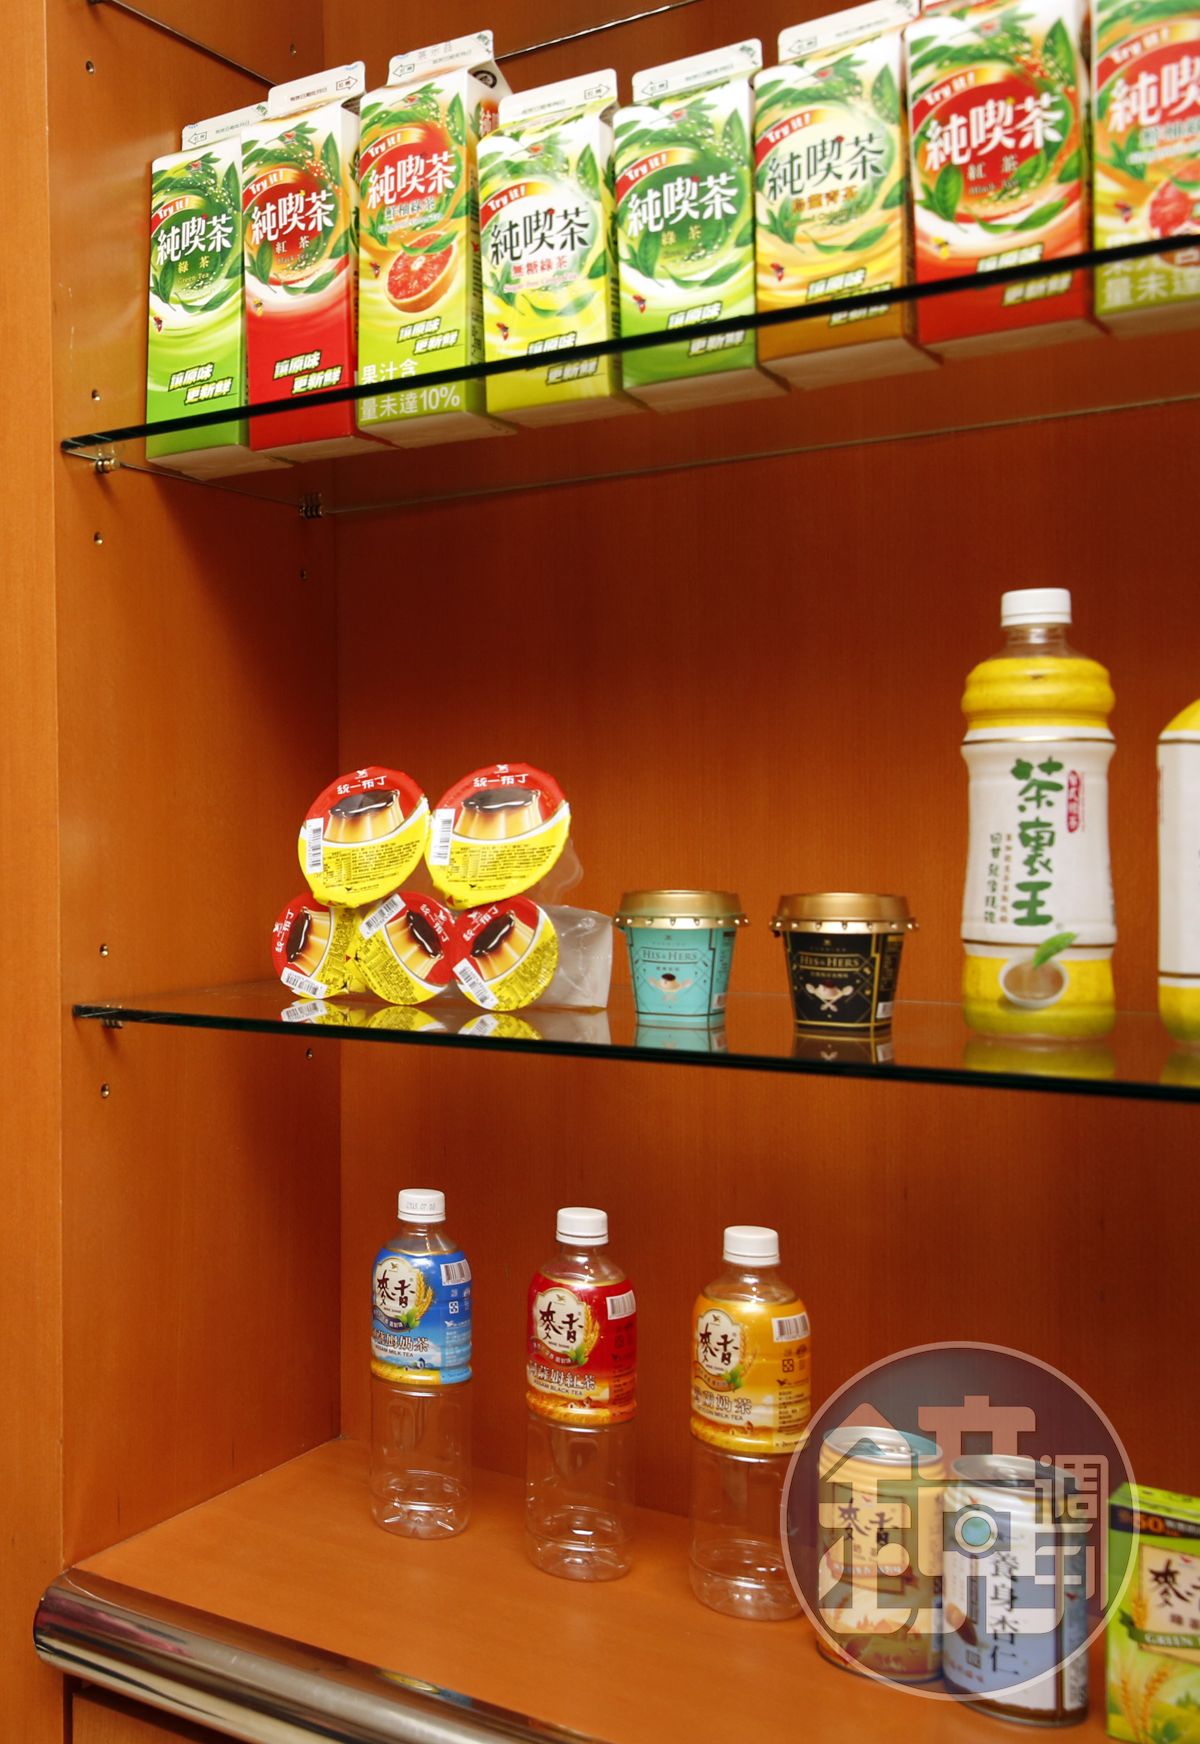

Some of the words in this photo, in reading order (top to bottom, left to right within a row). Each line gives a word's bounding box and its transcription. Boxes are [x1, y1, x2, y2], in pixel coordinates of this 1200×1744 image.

[1109, 42, 1141, 65] Try
[1143, 28, 1169, 50] it!
[924, 85, 951, 106] Try
[953, 72, 976, 91] it!
[767, 124, 789, 143] Try
[790, 112, 812, 131] it!
[924, 92, 1064, 171] 純喫茶
[368, 142, 386, 157] Try
[387, 133, 401, 147] it!
[367, 150, 457, 209] 純喫茶
[625, 164, 649, 181] Try
[650, 152, 667, 170] it!
[767, 133, 887, 201] 純喫茶
[249, 178, 269, 195] Try
[269, 171, 284, 187] it!
[158, 203, 174, 219] Try
[174, 196, 190, 213] it!
[487, 196, 508, 211] Try
[508, 185, 526, 201] it!
[626, 172, 739, 238] 純喫茶
[251, 189, 336, 245] 純喫茶
[156, 213, 234, 266] 純喫茶
[275, 235, 310, 254] 紅茶
[490, 206, 590, 266] 純喫茶
[176, 255, 210, 274] 綠茶
[169, 362, 215, 391] 讓原味
[273, 350, 322, 379] 讓原味
[185, 377, 234, 405] 更新鮮
[292, 365, 344, 394] 更新鮮
[336, 775, 387, 795] 統一布丁
[473, 773, 529, 788] 統一布丁
[1010, 756, 1064, 927] 茶裏王
[642, 950, 661, 960] HIS
[670, 951, 698, 962] HERS
[801, 956, 818, 966] HIS
[827, 956, 860, 968] HERS
[377, 1269, 416, 1309] 麥香
[539, 1301, 585, 1344] 麥香
[699, 1322, 740, 1366] 麥香
[550, 1384, 569, 1394] BLACK
[571, 1389, 583, 1397] TEA
[715, 1410, 730, 1421] MILK
[731, 1414, 744, 1422] TEA
[1148, 1558, 1200, 1608] 麥
[1144, 1630, 1194, 1647] GREEN
